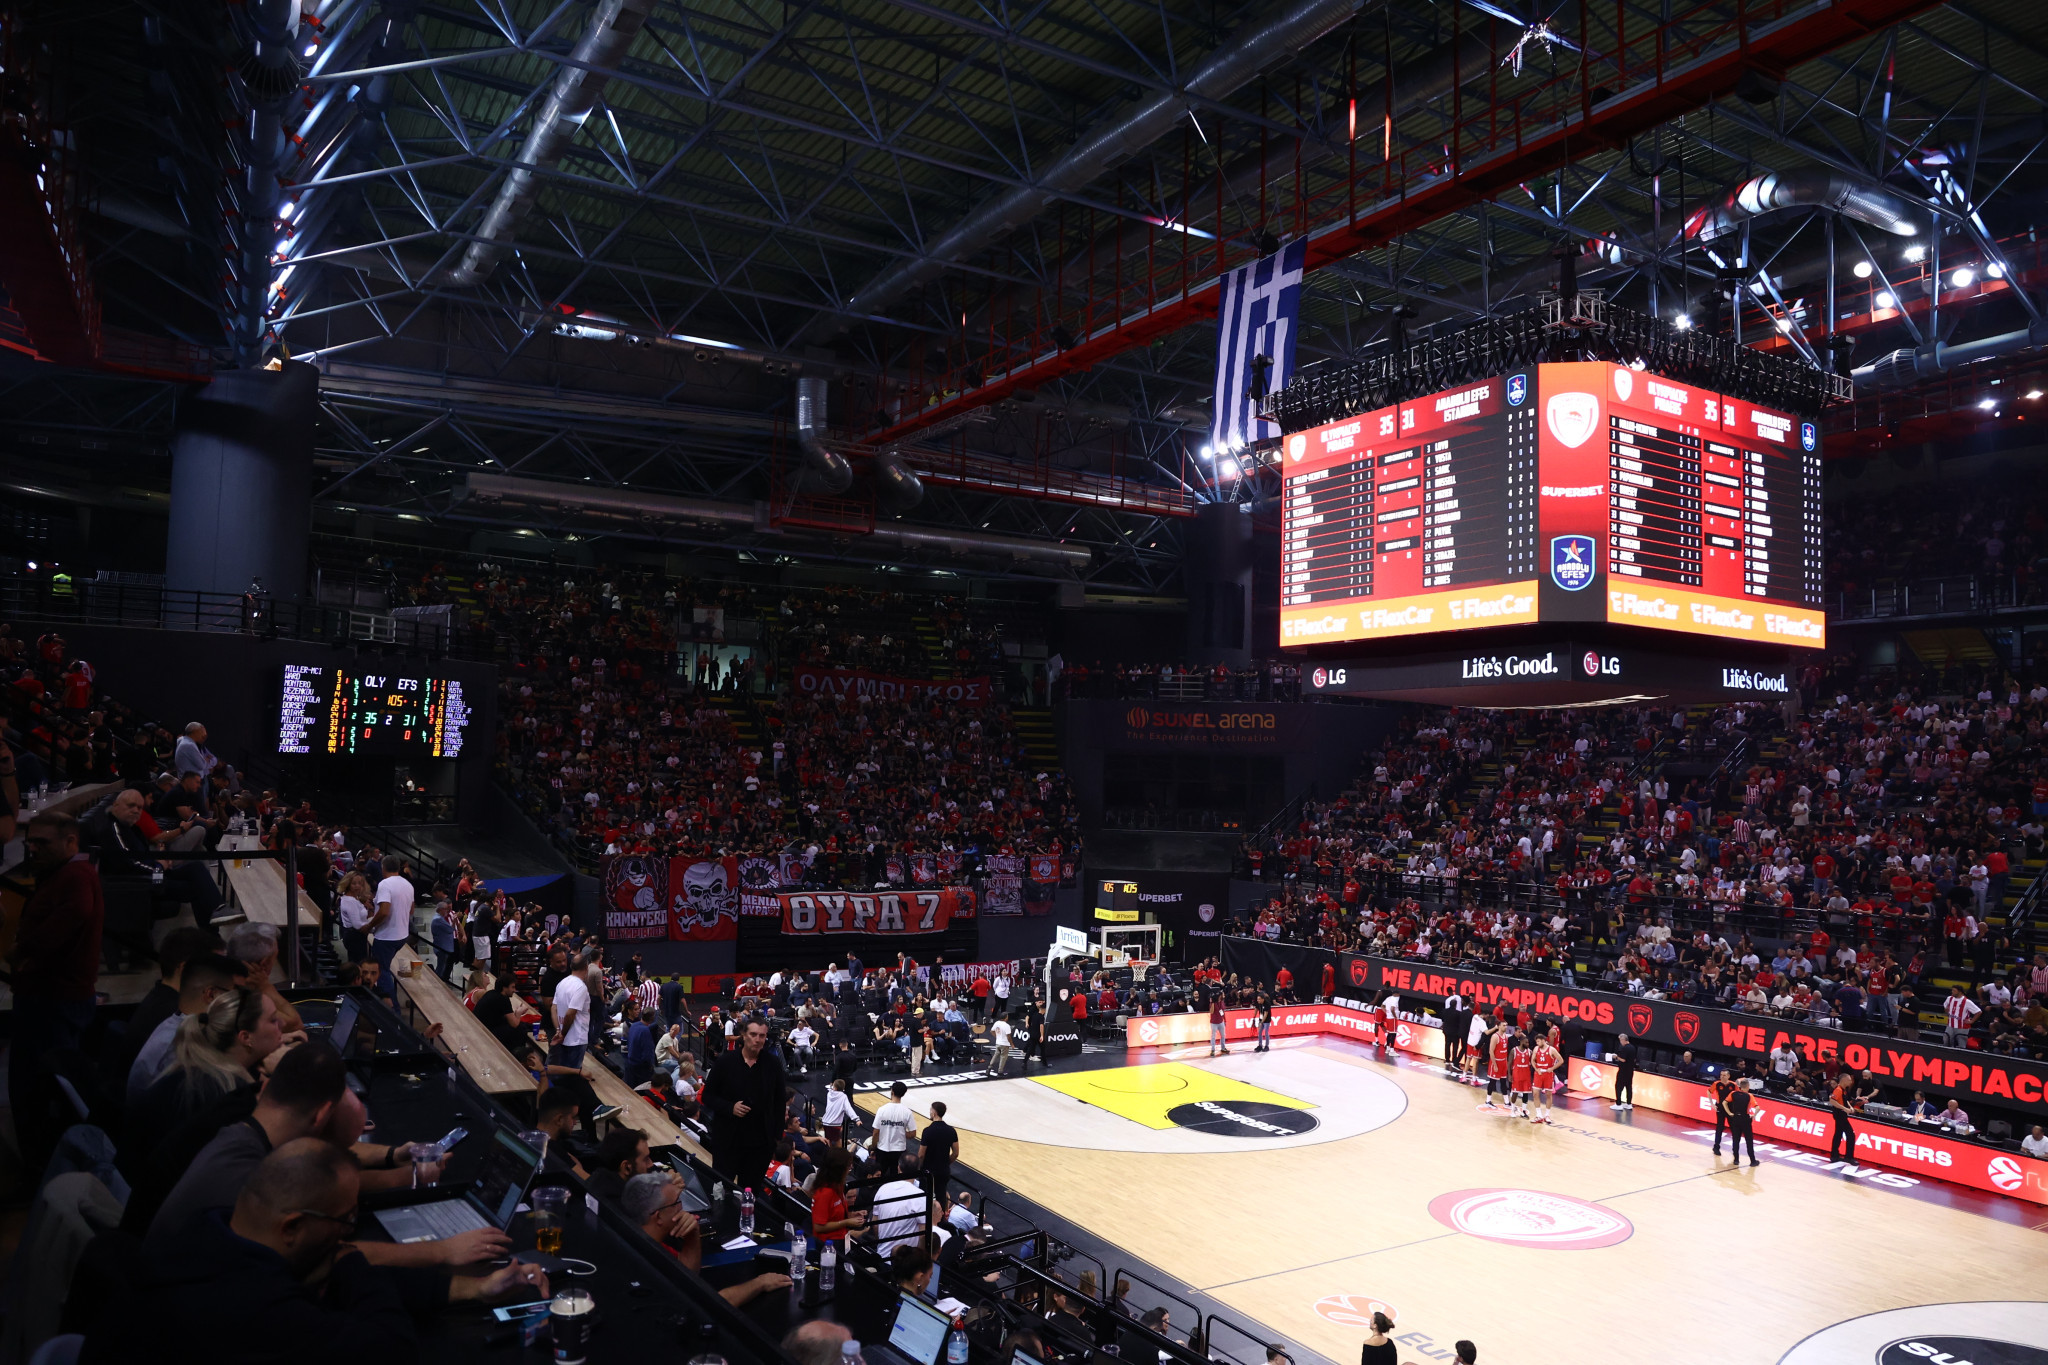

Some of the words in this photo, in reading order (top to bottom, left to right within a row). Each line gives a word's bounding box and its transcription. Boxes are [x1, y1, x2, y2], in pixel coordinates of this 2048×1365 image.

[1471, 386, 1489, 402] EFES
[1704, 399, 1718, 422] 35
[1723, 404, 1736, 427] 31
[1379, 414, 1394, 436] 35
[1402, 408, 1415, 430] 31
[1427, 445, 1430, 453] 3
[1427, 457, 1430, 465] 4
[1427, 469, 1430, 477] 5
[1426, 481, 1431, 489] 11
[1541, 485, 1603, 497] SUPERBET
[1426, 505, 1431, 513] 17
[1425, 529, 1432, 537] 22
[1557, 563, 1590, 573] ANADOLU
[1562, 571, 1585, 579] EFES
[1464, 594, 1534, 619] FlexCar
[1624, 594, 1679, 619] FlexCar
[1373, 606, 1434, 628] FlexCar
[1703, 605, 1754, 629] FlexCar
[1294, 616, 1348, 636] FlexCar
[1775, 614, 1822, 638] FlexCar
[285, 665, 322, 675] MILLER-MCI
[1462, 656, 1502, 679] Life's
[1505, 652, 1558, 676] Good.
[1601, 656, 1620, 675] LG
[284, 680, 311, 688] MONTERO
[365, 675, 386, 688] OLY
[398, 678, 418, 691] EFS
[1328, 668, 1346, 684] LG
[1723, 668, 1752, 689] Life's
[1753, 672, 1788, 692] Good.
[799, 673, 981, 700] ΟΛΥΜΠΙΚΟΣ
[283, 694, 320, 703] PAPANIKOLA
[281, 716, 315, 724] MILUTINOV
[364, 712, 377, 724] 35
[385, 715, 392, 725] 2
[403, 714, 416, 726] 31
[1152, 712, 1216, 728] SUNEL
[1218, 713, 1275, 728] arena
[364, 728, 372, 739] 0
[404, 730, 411, 740] 0
[1127, 731, 1144, 740] The
[1149, 732, 1208, 742] Experience
[1212, 733, 1276, 742] Destination
[605, 909, 667, 927] KAMATERO
[788, 893, 905, 931] ΘΥΡΑ
[916, 893, 941, 930] 7
[1381, 966, 1412, 990] WE
[1413, 972, 1457, 997] ARE
[1460, 980, 1615, 1025] OLYMPIACOS
[1235, 1016, 1281, 1029] EVEY
[1285, 1013, 1318, 1025] GAME
[1013, 1028, 1030, 1042] NO
[1047, 1033, 1079, 1042] NOVA
[1721, 1022, 1767, 1053] WE
[1770, 1031, 1838, 1063] ARE
[1844, 1043, 2048, 1103] OLYMPIAC
[853, 1069, 999, 1091] UPERBET
[1194, 1101, 1296, 1136] SUPERBET
[1546, 1119, 1680, 1160] uroLeague
[1773, 1114, 1825, 1137] GAME
[1849, 1130, 1953, 1167] ATTERS
